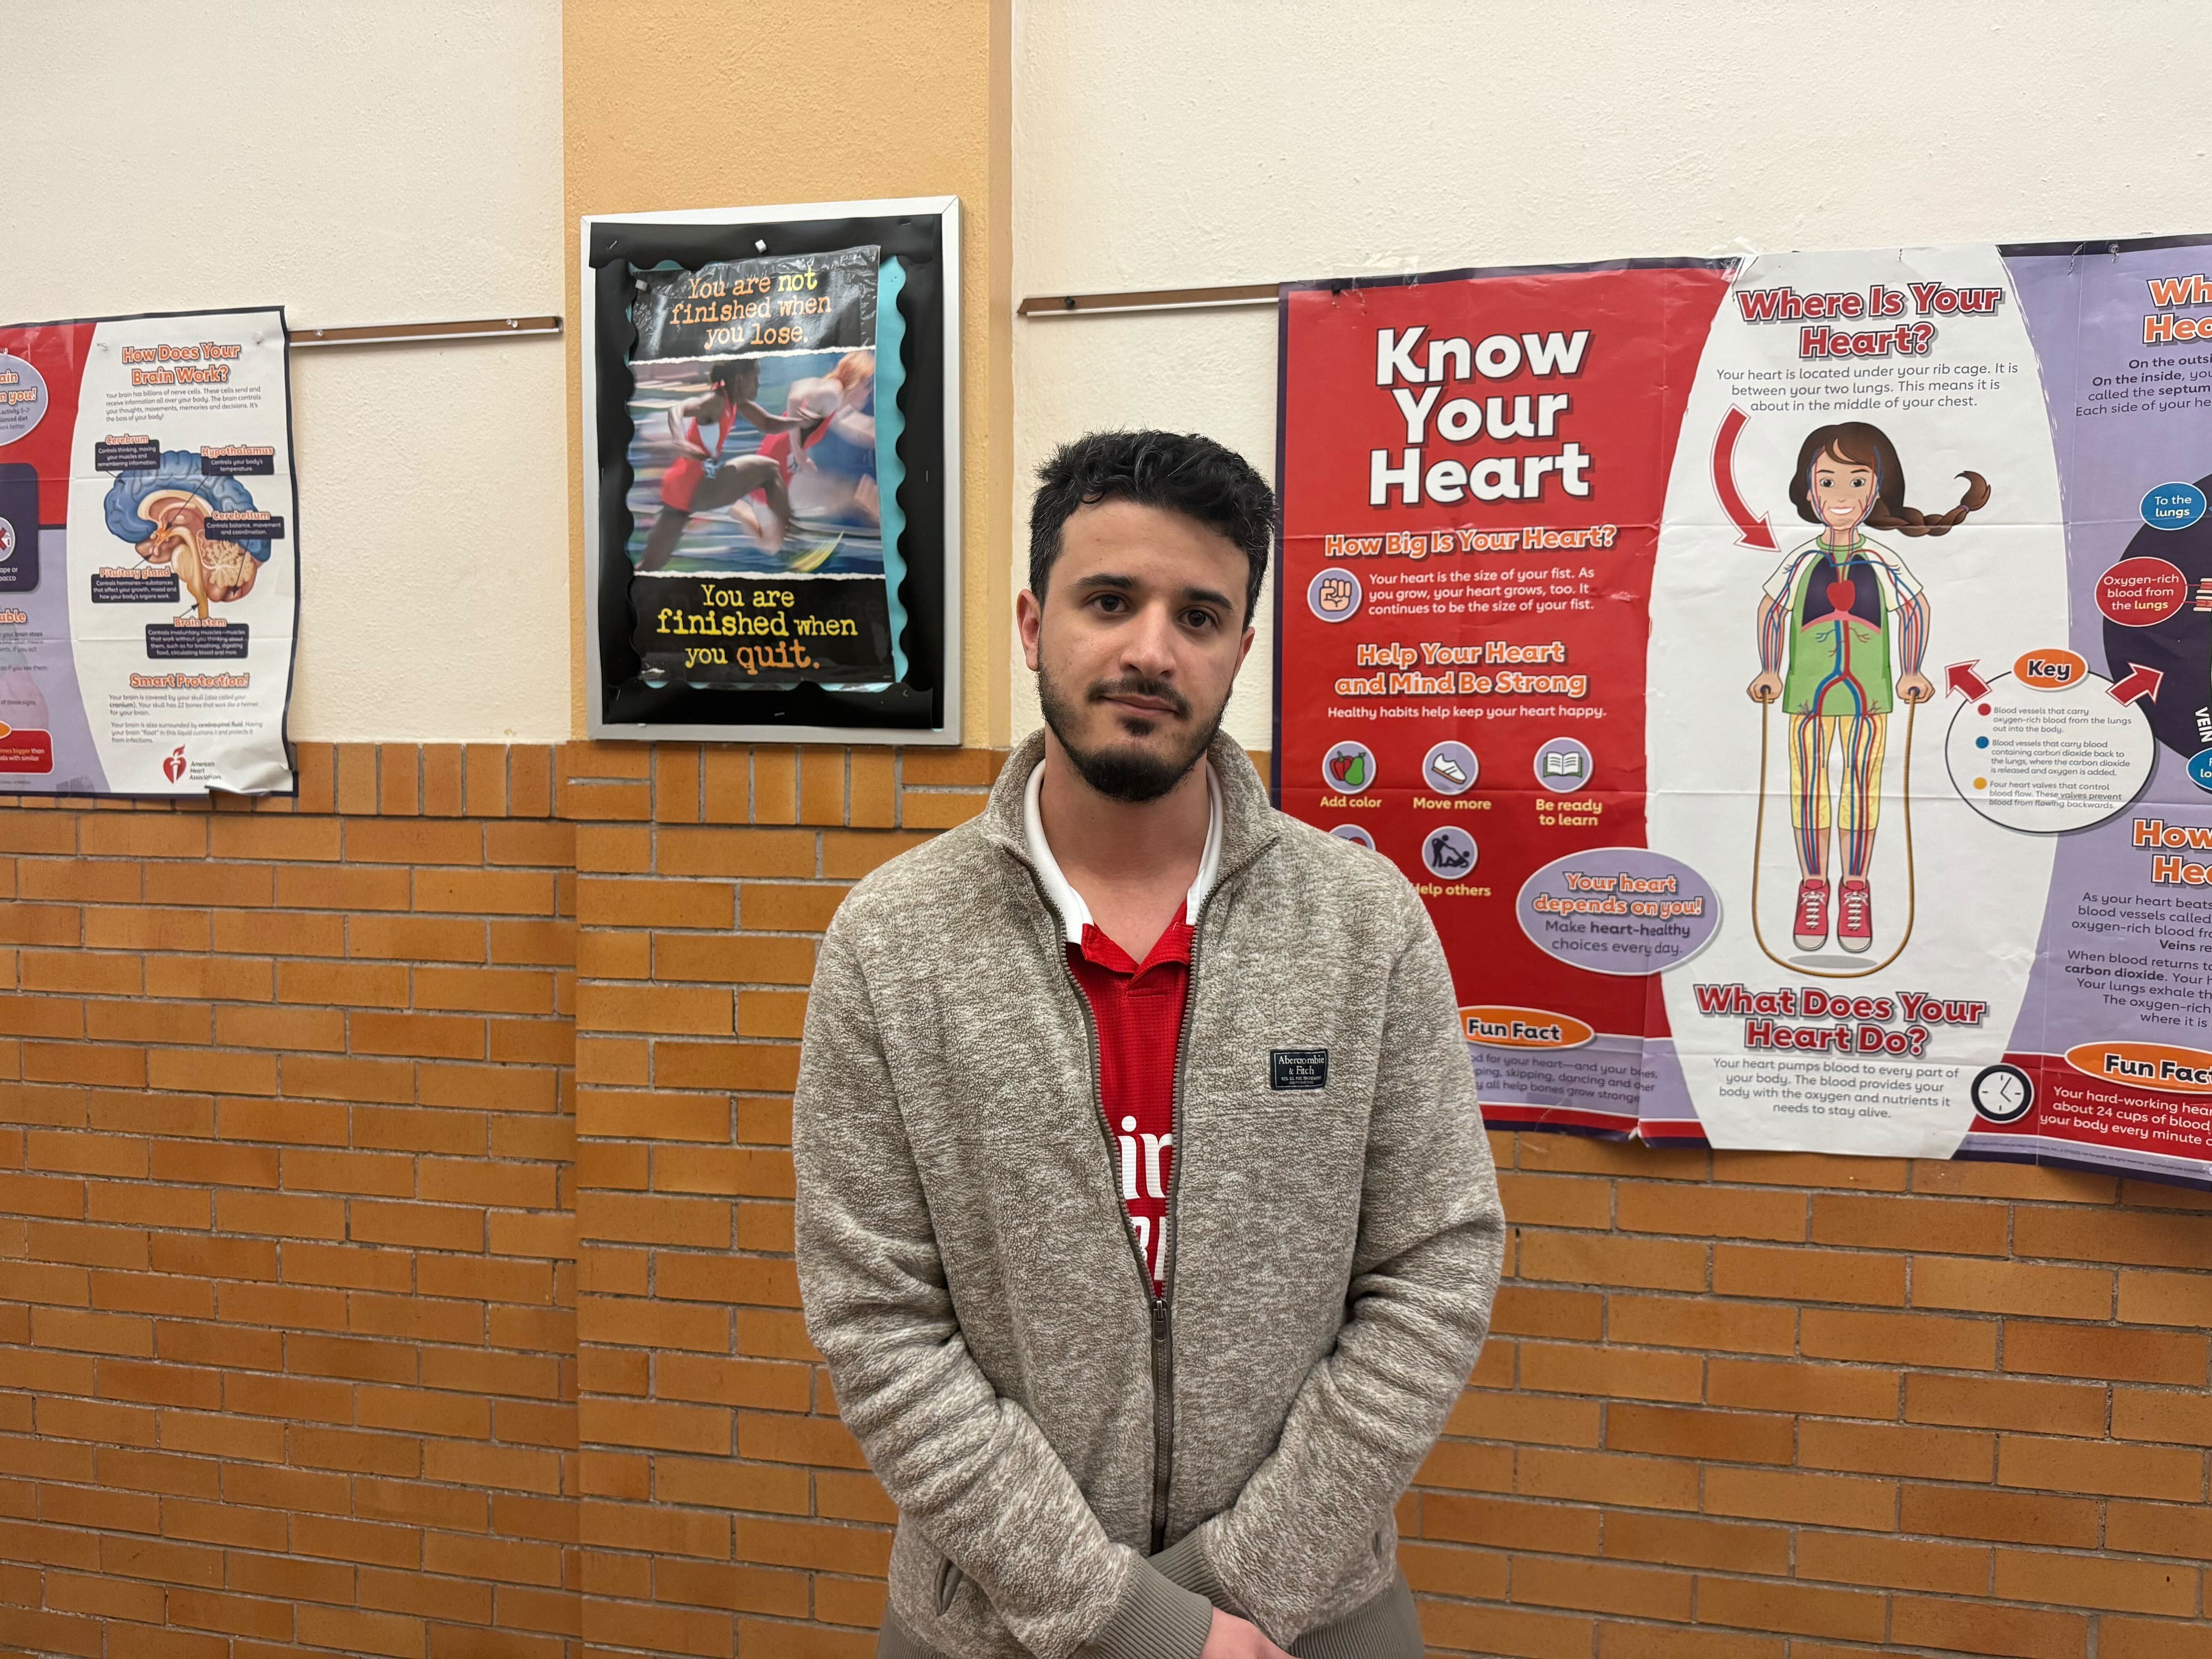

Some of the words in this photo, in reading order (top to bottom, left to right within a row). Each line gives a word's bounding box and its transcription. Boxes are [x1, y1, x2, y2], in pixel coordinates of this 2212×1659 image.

[688, 278, 725, 299] You
[733, 276, 771, 295] are
[778, 267, 817, 292] not
[670, 297, 771, 324] finished
[778, 295, 831, 316] when
[1736, 287, 1864, 322] Where
[1869, 284, 1904, 316] Is
[1907, 282, 2005, 314] Your
[704, 325, 744, 349] you
[751, 323, 808, 345] lose.
[1799, 321, 1935, 359] Heart?
[122, 347, 156, 364] How
[158, 346, 199, 361] Does
[201, 342, 240, 359] Your
[1376, 325, 1591, 386] Know
[132, 369, 174, 386] Brain
[176, 366, 229, 384] Work?
[1717, 369, 1745, 381] Your
[1748, 369, 1782, 380] heart
[1786, 369, 1796, 379] is
[1799, 367, 1851, 379] located
[1853, 367, 1895, 378] under
[1898, 366, 1929, 377] your
[1933, 364, 1949, 374] rib
[1954, 364, 1990, 375] cage.
[1995, 363, 2005, 373] It
[2008, 363, 2018, 373] is
[2092, 377, 2111, 386] On
[2115, 374, 2137, 384] the
[2141, 371, 2185, 382] inside,
[8, 387, 37, 405] you!
[1391, 386, 1570, 445] Your
[105, 434, 149, 445] Cerebrum
[201, 445, 274, 458] Hypothalamus
[1369, 441, 1591, 505] Heart
[2155, 496, 2168, 505] To
[2172, 495, 2191, 504] the
[213, 510, 270, 520] Cerebellum
[2155, 508, 2190, 518] lungs
[1324, 534, 1381, 556] How
[1386, 532, 1427, 558] Big
[1431, 531, 1454, 553] Is
[1456, 528, 1518, 551] Your
[1522, 525, 1617, 550] Heart?
[100, 567, 141, 579] Pituitary
[141, 566, 171, 579] gland
[1369, 573, 1397, 585] Your
[1400, 572, 1434, 583] heart
[1437, 572, 1447, 582] is
[1450, 571, 1470, 582] the
[1474, 570, 1498, 581] size
[1501, 569, 1515, 580] of
[1518, 569, 1549, 581] your
[1551, 568, 1574, 579] fist.
[1579, 567, 1594, 578] As
[2104, 574, 2179, 587] Oxygen-rich
[701, 584, 745, 607] You
[753, 591, 795, 608] are
[2107, 587, 2142, 598] blood
[2112, 601, 2131, 610] the
[2135, 601, 2168, 611] lungs
[173, 616, 201, 627] Brain
[201, 617, 227, 627] stem
[657, 608, 789, 636] finished
[793, 615, 858, 635] when
[686, 647, 728, 668] you
[737, 639, 820, 675] quit.
[1357, 643, 1417, 669] Help
[1420, 642, 1481, 666] Your
[1485, 641, 1565, 663] Heart
[130, 673, 175, 688] Smart
[176, 672, 249, 688] Protection!
[2028, 659, 2071, 682] Key
[1335, 672, 1386, 694] and
[1389, 672, 1455, 694] Mind
[1458, 671, 1492, 694] Be
[1495, 670, 1587, 697] Strong
[1328, 707, 1376, 720] Healthy
[1380, 707, 1419, 718] habits
[1422, 706, 1451, 718] help
[1453, 706, 1483, 718] keep
[1486, 707, 1517, 718] your
[1520, 705, 1554, 716] heart
[1559, 706, 1606, 718] happy.
[1320, 797, 1346, 807] Add
[1349, 797, 1382, 807] color
[1413, 798, 1451, 809] Move
[1454, 800, 1491, 809] more
[1536, 799, 1555, 811] Be
[1558, 799, 1602, 814] ready
[1539, 815, 1555, 825] to
[1558, 814, 1598, 826] learn
[1446, 885, 1491, 896] others
[1563, 872, 1619, 890] Your
[1619, 872, 1676, 892] heart
[1532, 892, 1627, 917] depends
[1628, 900, 1658, 915] on
[1659, 895, 1704, 920] you!
[2083, 892, 2097, 902] As
[2102, 895, 2131, 905] your
[2136, 895, 2172, 907] heart
[2065, 965, 2111, 976] carbon
[2114, 968, 2167, 981] dioxide.
[2172, 973, 2203, 984] Your
[1693, 983, 1796, 1017] What
[1801, 987, 1892, 1021] Does
[1896, 991, 1986, 1025] Your
[1467, 1018, 1508, 1037] Fun
[1511, 1021, 1562, 1042] Fact
[1745, 1018, 1851, 1052] Heart
[1856, 1023, 1929, 1056] Do?
[1296, 1066, 1314, 1074] Fitch
[2053, 1086, 2083, 1099] Your
[2087, 1091, 2178, 1113] hard-working
[1773, 1103, 1809, 1113] needs
[1812, 1105, 1825, 1114] to
[1829, 1106, 1855, 1119] stay
[1858, 1108, 1891, 1119] alive.
[2053, 1102, 2093, 1115] about
[2097, 1107, 2113, 1116] 24
[2116, 1111, 2148, 1122] cups
[2152, 1115, 2166, 1124] of
[2170, 1115, 2210, 1131] blood
